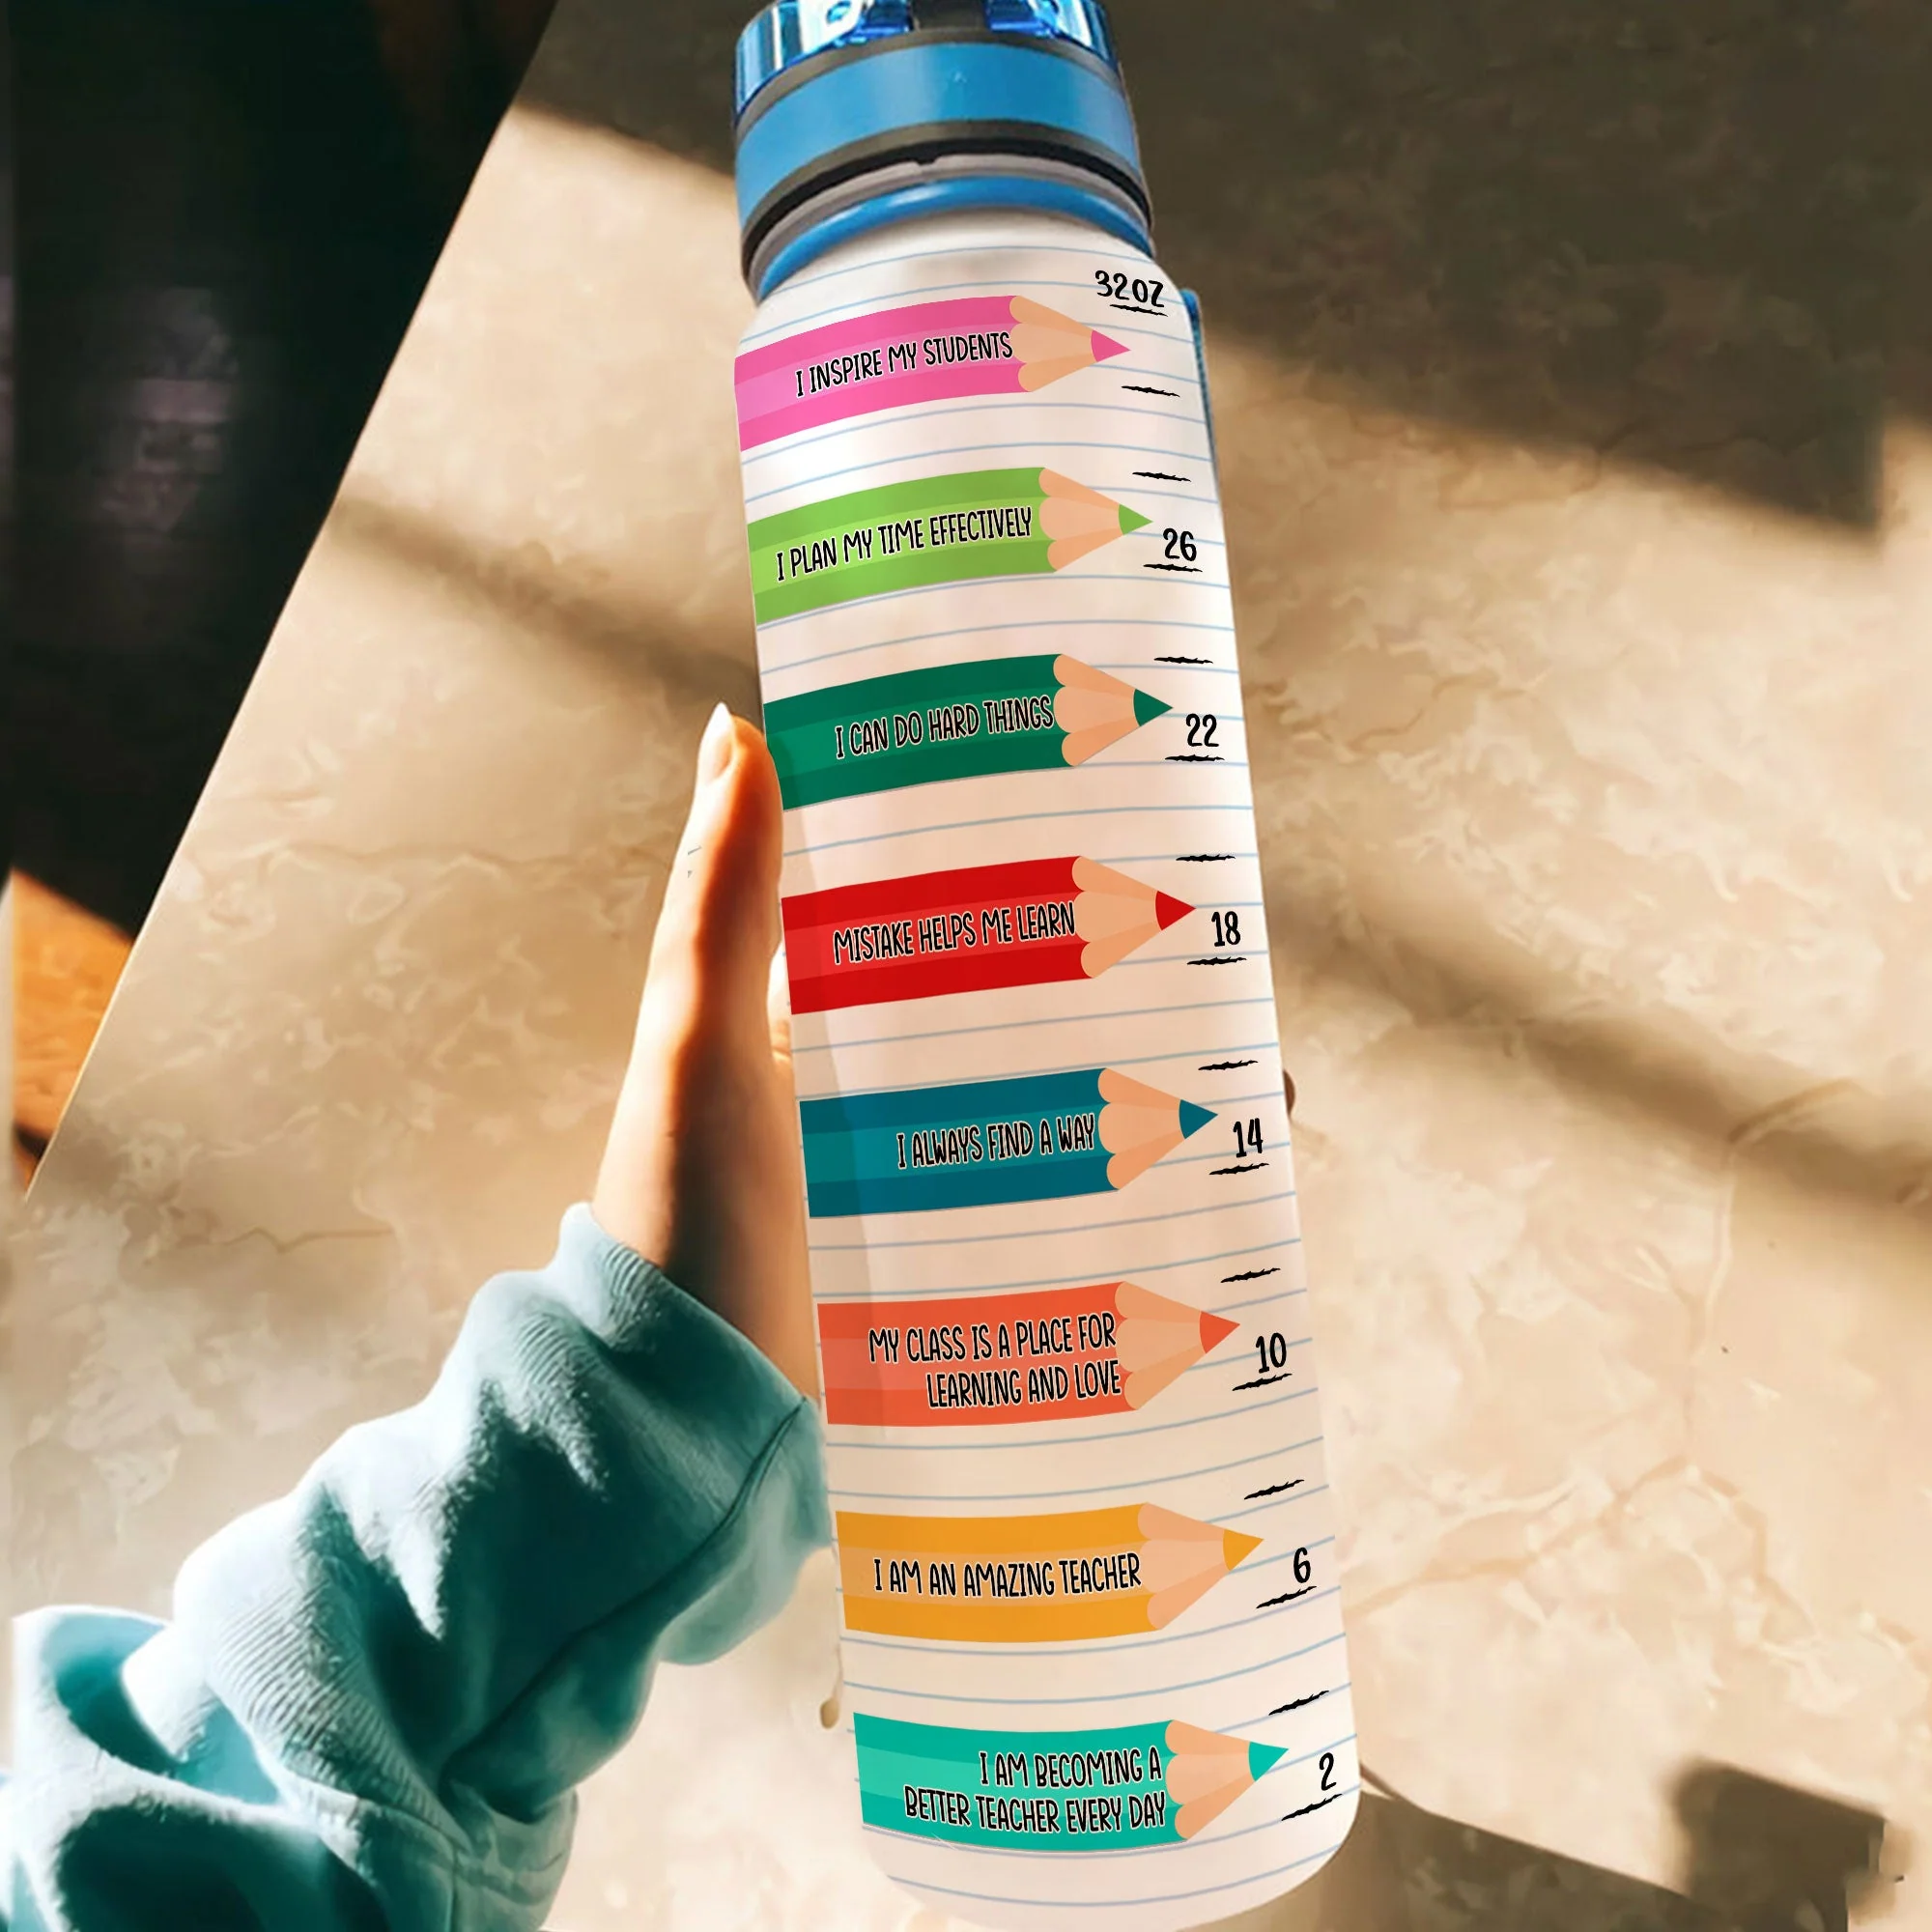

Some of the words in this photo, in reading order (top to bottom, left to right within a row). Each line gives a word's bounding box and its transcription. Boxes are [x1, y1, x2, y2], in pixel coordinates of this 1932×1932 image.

[795, 369, 805, 398] I
[808, 348, 884, 394] INSPIRE
[887, 341, 918, 373] MY
[922, 330, 1014, 366] STUDENTS
[776, 551, 785, 582] I
[788, 536, 838, 579] PLAN
[842, 527, 873, 564] MY
[876, 518, 925, 555] TIME
[928, 505, 1033, 547] EFFECTIVELY
[1162, 527, 1197, 562] 26
[835, 725, 845, 759] I
[849, 717, 889, 755] CAN
[894, 711, 923, 748] DO
[927, 703, 980, 742] HARD
[982, 695, 1055, 734] THINGS
[1185, 713, 1219, 748] 22
[833, 921, 915, 965] MISTAKE
[918, 911, 977, 953] HELPS
[980, 908, 1013, 945] ME
[1015, 901, 1076, 941] LEARN
[1210, 911, 1241, 948] 18
[896, 1133, 907, 1169] I
[911, 1125, 984, 1168] ALWAYS
[986, 1121, 1035, 1160] FIND
[1039, 1119, 1054, 1155] A
[1056, 1113, 1095, 1152] WAY
[1233, 1118, 1264, 1158] 14
[867, 1327, 900, 1364] MY
[905, 1324, 967, 1363] CLASS
[970, 1323, 993, 1361] IS
[997, 1323, 1011, 1359] A
[1014, 1317, 1074, 1357] PLACE
[1077, 1311, 1118, 1351] FOR
[1255, 1332, 1287, 1374] 10
[925, 1369, 1023, 1408] LEARNING
[1027, 1365, 1069, 1404] AND
[1073, 1358, 1122, 1400] LOVE
[873, 1557, 884, 1592] I
[889, 1559, 923, 1595] AM
[928, 1562, 957, 1597] AN
[963, 1561, 1056, 1599] AMAZING
[1057, 1551, 1143, 1595] TEACHER
[1293, 1547, 1311, 1584] 6
[979, 1751, 989, 1786] I
[994, 1752, 1030, 1787] AM
[1033, 1747, 1144, 1789] BECOMING
[1148, 1746, 1163, 1781] A
[1319, 1752, 1337, 1791] 2
[903, 1784, 972, 1827] BETTER
[974, 1794, 1061, 1833] TEACHER
[1065, 1796, 1122, 1833] EVERY
[1127, 1790, 1166, 1829] DAY
